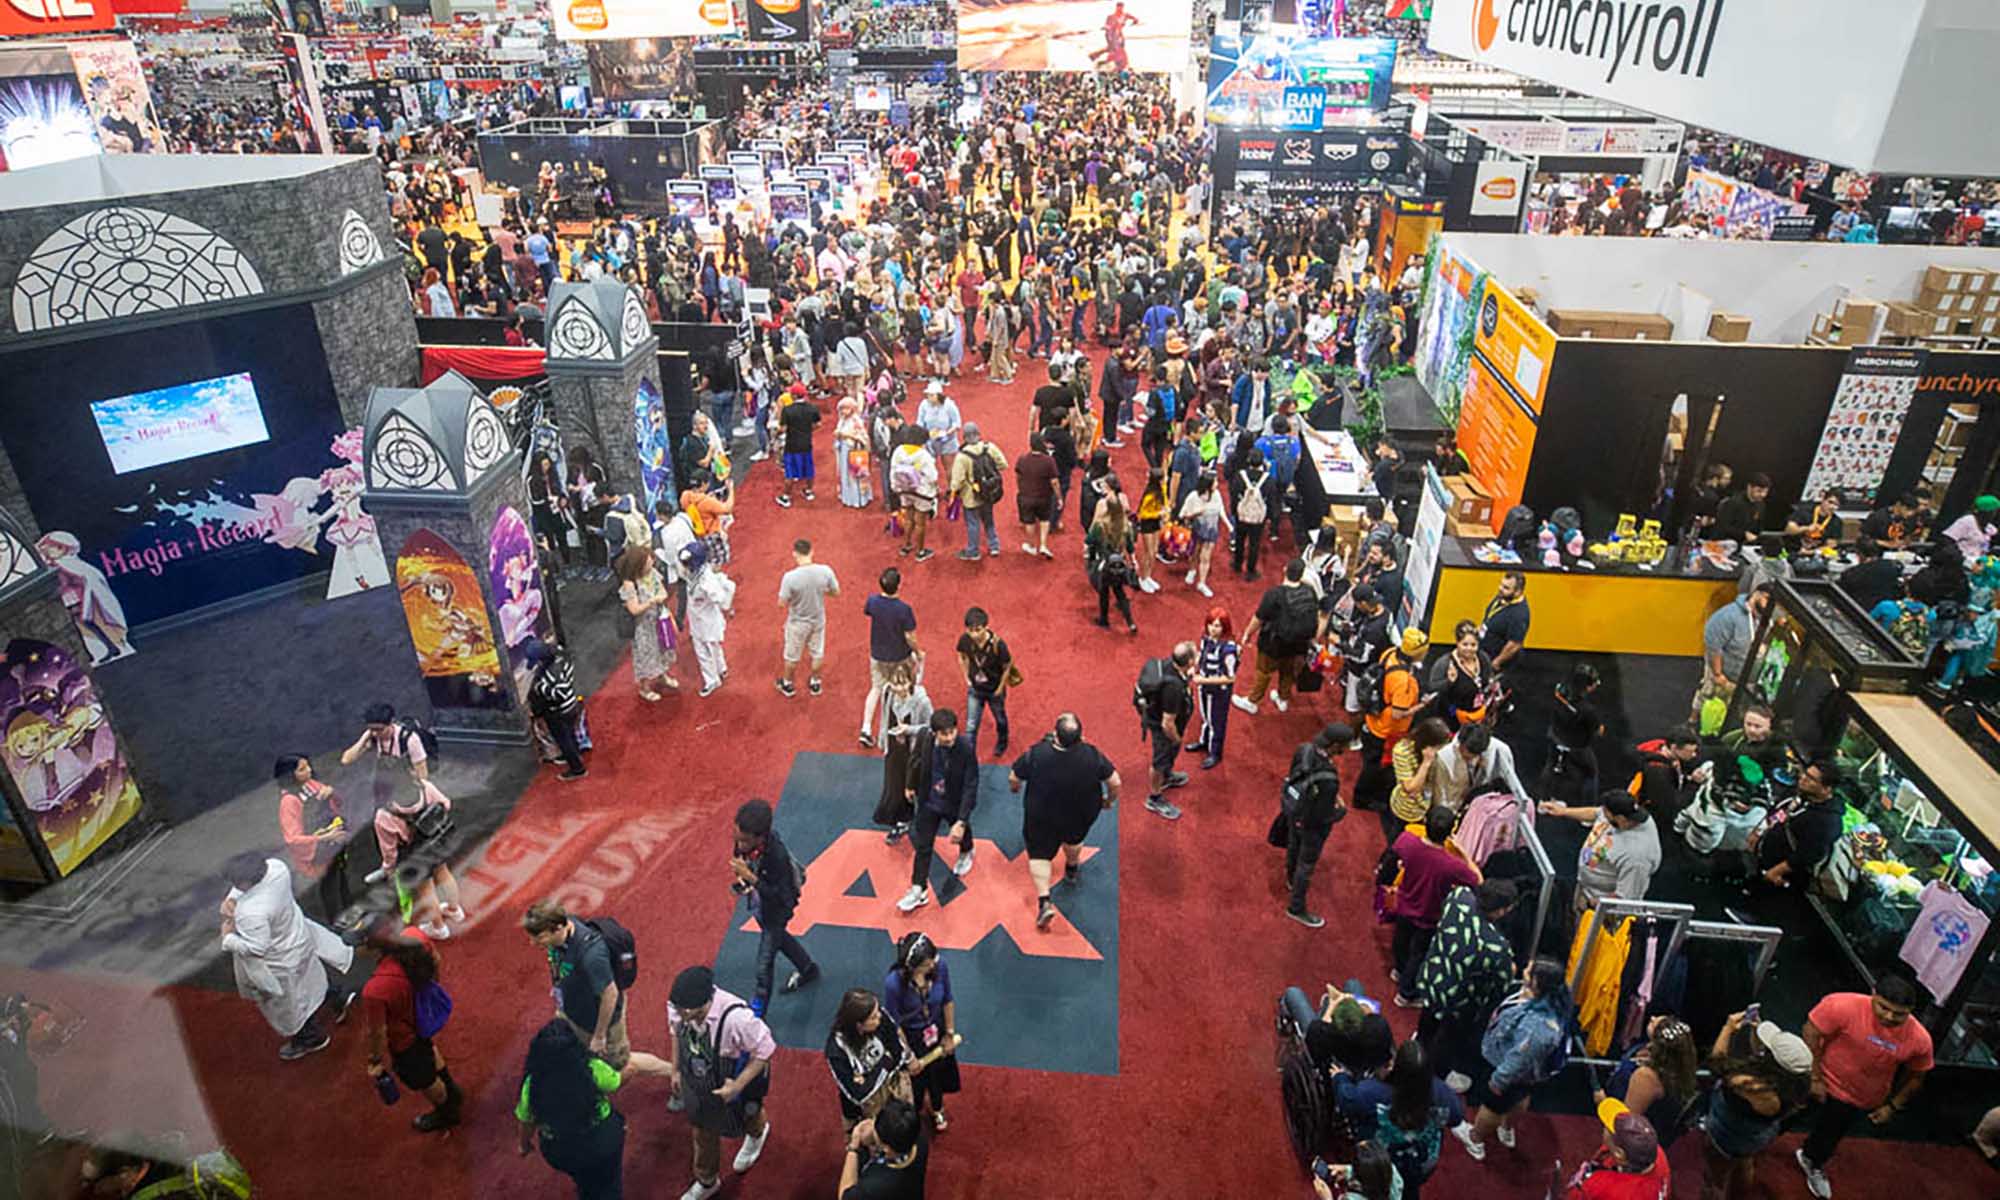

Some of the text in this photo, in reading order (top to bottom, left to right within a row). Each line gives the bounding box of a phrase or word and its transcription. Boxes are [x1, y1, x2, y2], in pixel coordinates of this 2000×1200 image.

[1507, 0, 1723, 84] crunchyroll
[1286, 92, 1323, 109] BAN
[1854, 357, 1919, 368] MERCH MENU
[100, 505, 285, 577] Magia Record
